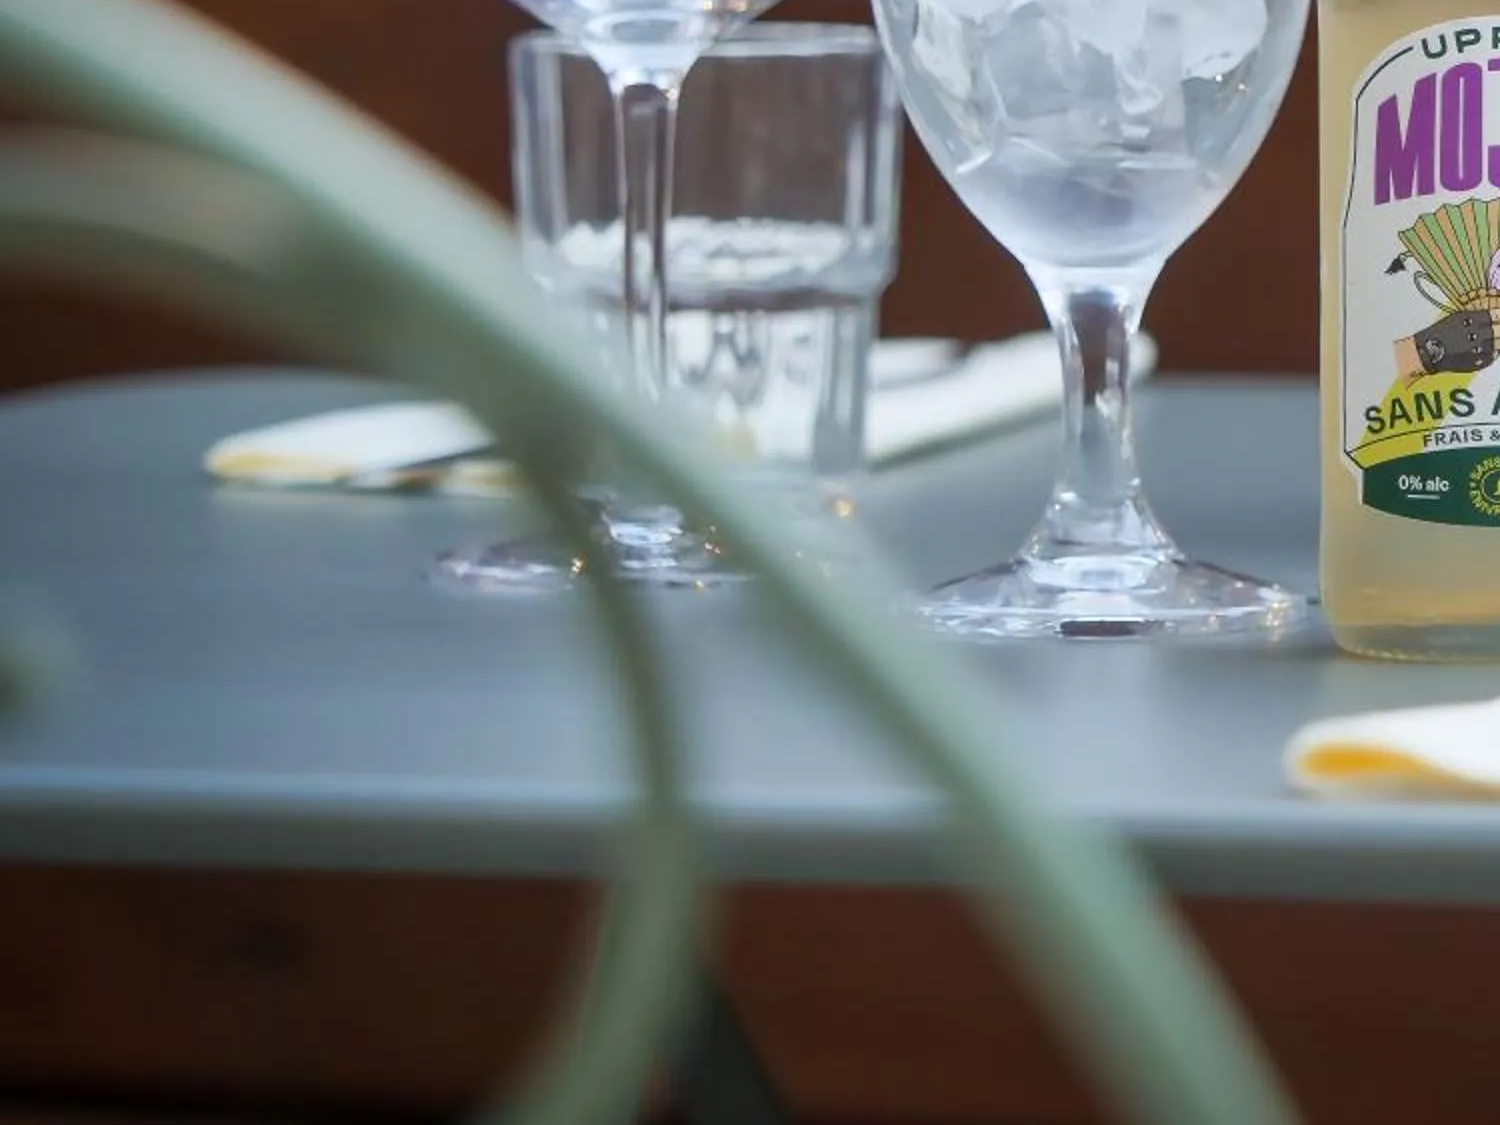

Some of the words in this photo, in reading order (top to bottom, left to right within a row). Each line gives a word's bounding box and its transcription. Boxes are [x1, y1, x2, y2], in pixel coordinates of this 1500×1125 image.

[1364, 387, 1476, 435] SANS
[1422, 427, 1484, 448] FRAIS
[1489, 429, 1500, 442] &
[1397, 475, 1422, 491] 0%
[1424, 475, 1451, 493] alc
